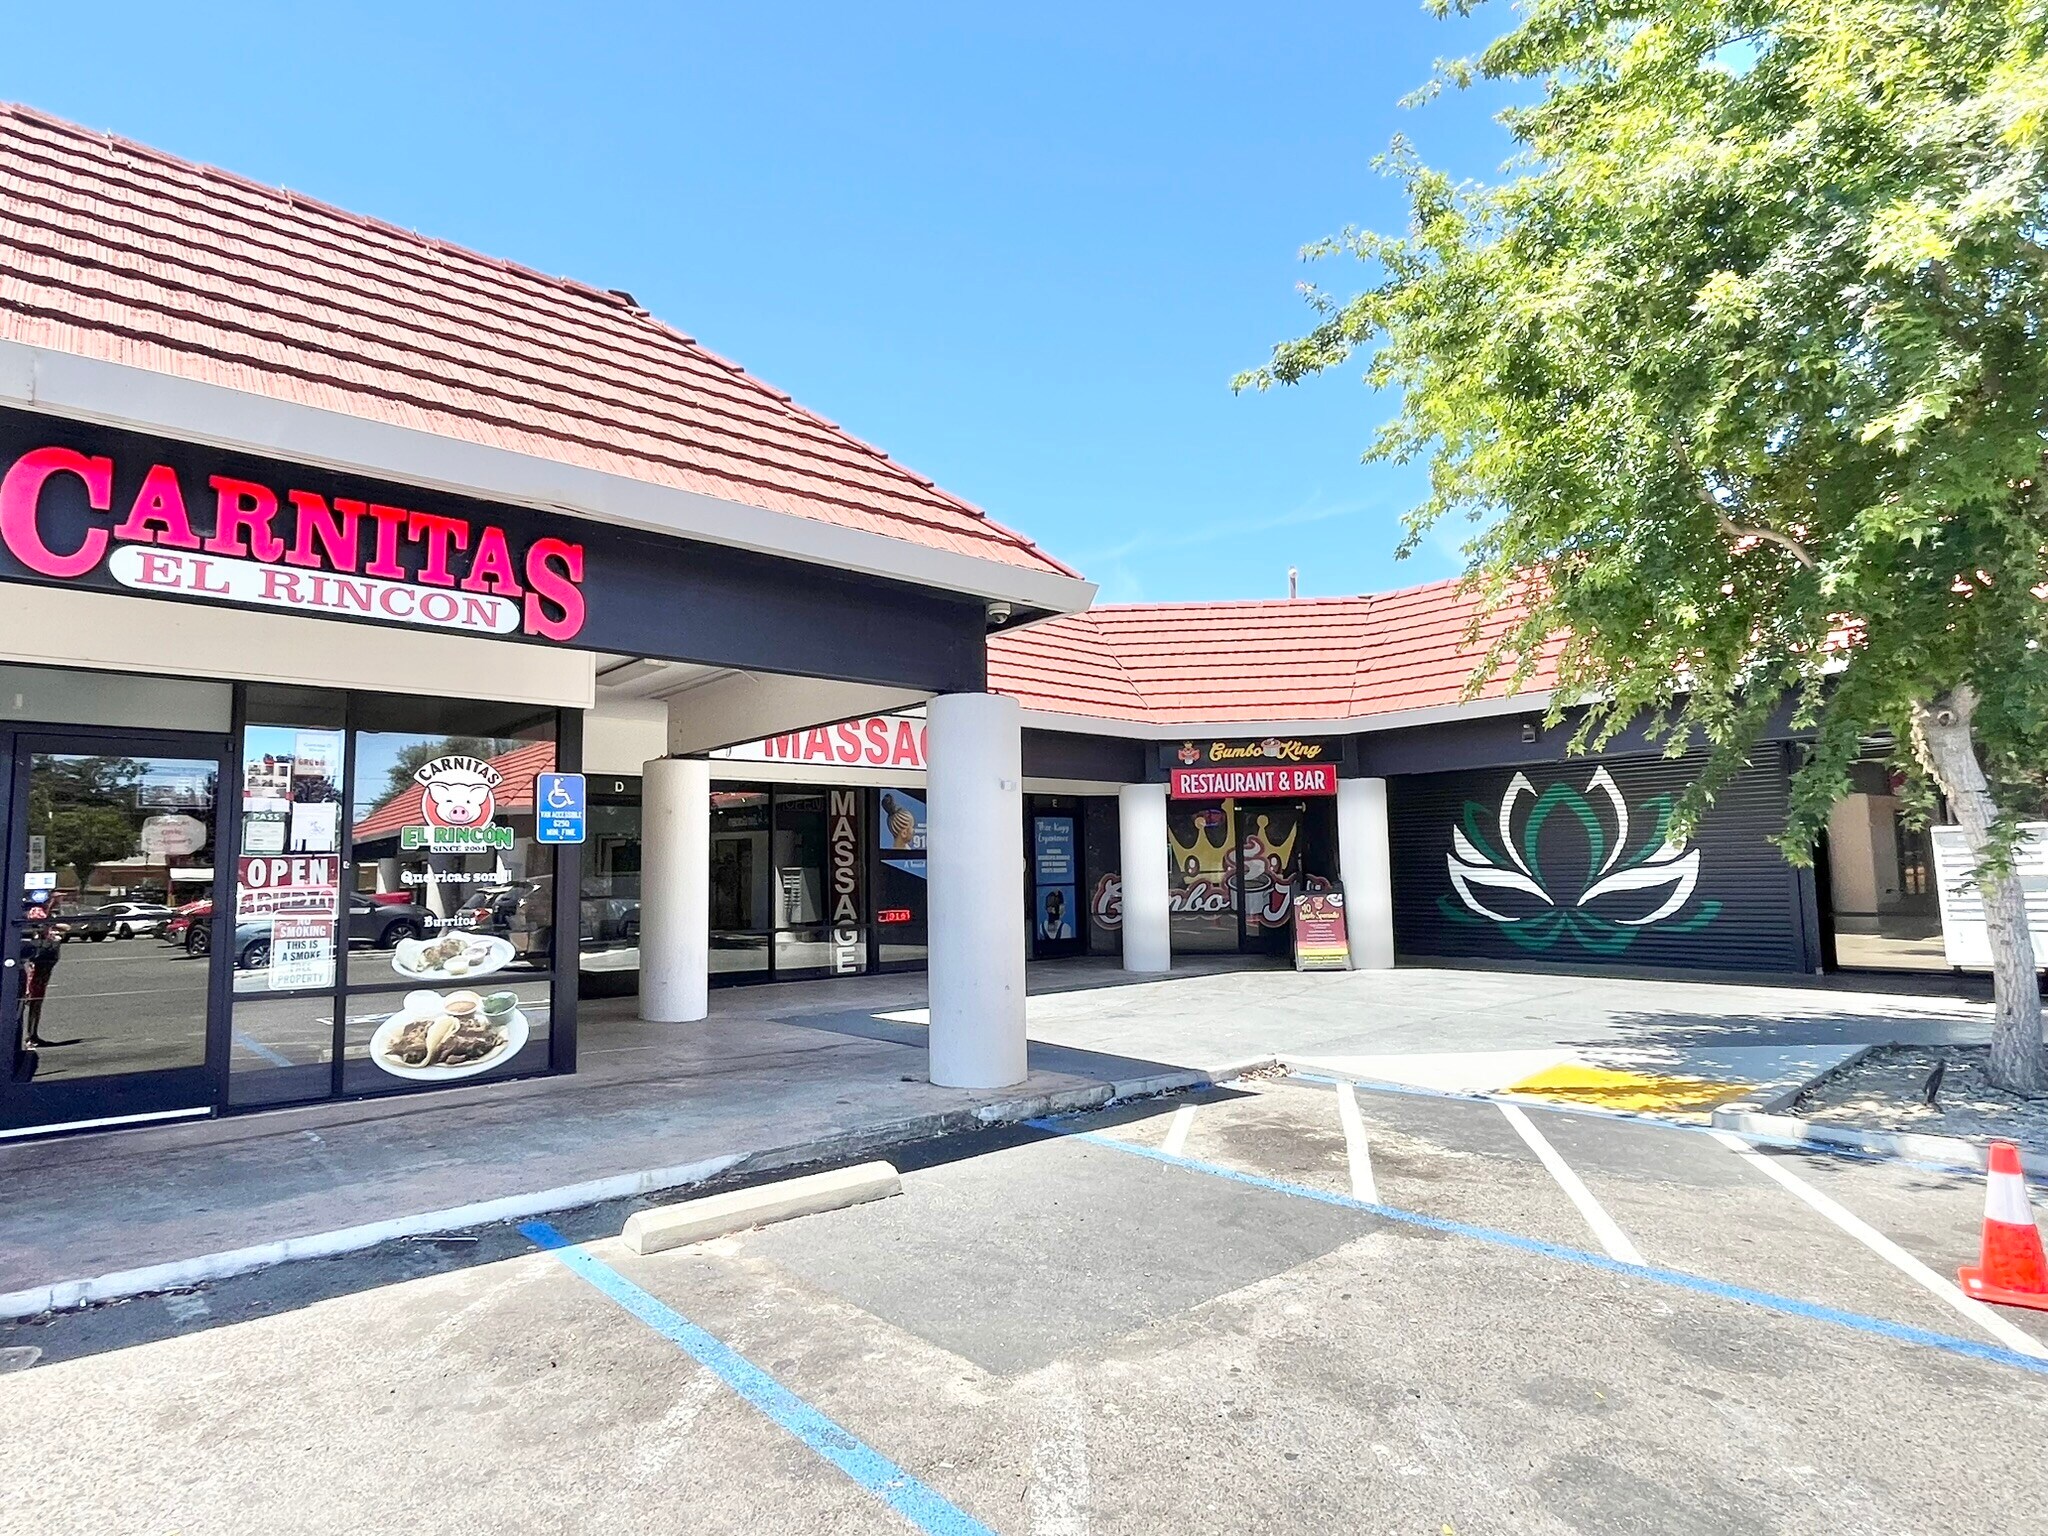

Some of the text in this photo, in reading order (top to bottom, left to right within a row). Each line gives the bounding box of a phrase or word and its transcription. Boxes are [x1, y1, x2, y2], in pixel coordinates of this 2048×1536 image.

[0, 446, 586, 641] CARNITAS
[135, 551, 503, 628] EL RINCON
[764, 718, 927, 766] MASSA
[1208, 741, 1322, 762] Gumbo King
[418, 757, 502, 785] CARNITAS
[1180, 770, 1325, 793] RESTAURANT & BAR
[615, 781, 624, 793] D
[253, 812, 280, 821] PASS
[402, 822, 512, 848] EL RINCÓN
[247, 858, 329, 887] OPEN
[434, 870, 471, 883] ricas
[831, 790, 858, 973] MASSAGE
[424, 913, 477, 928] Burritos
[280, 925, 326, 938] SMOKING
[286, 940, 318, 949] THIS IS
[281, 951, 321, 962] A SMOKE
[277, 973, 324, 984] PROPERTY
